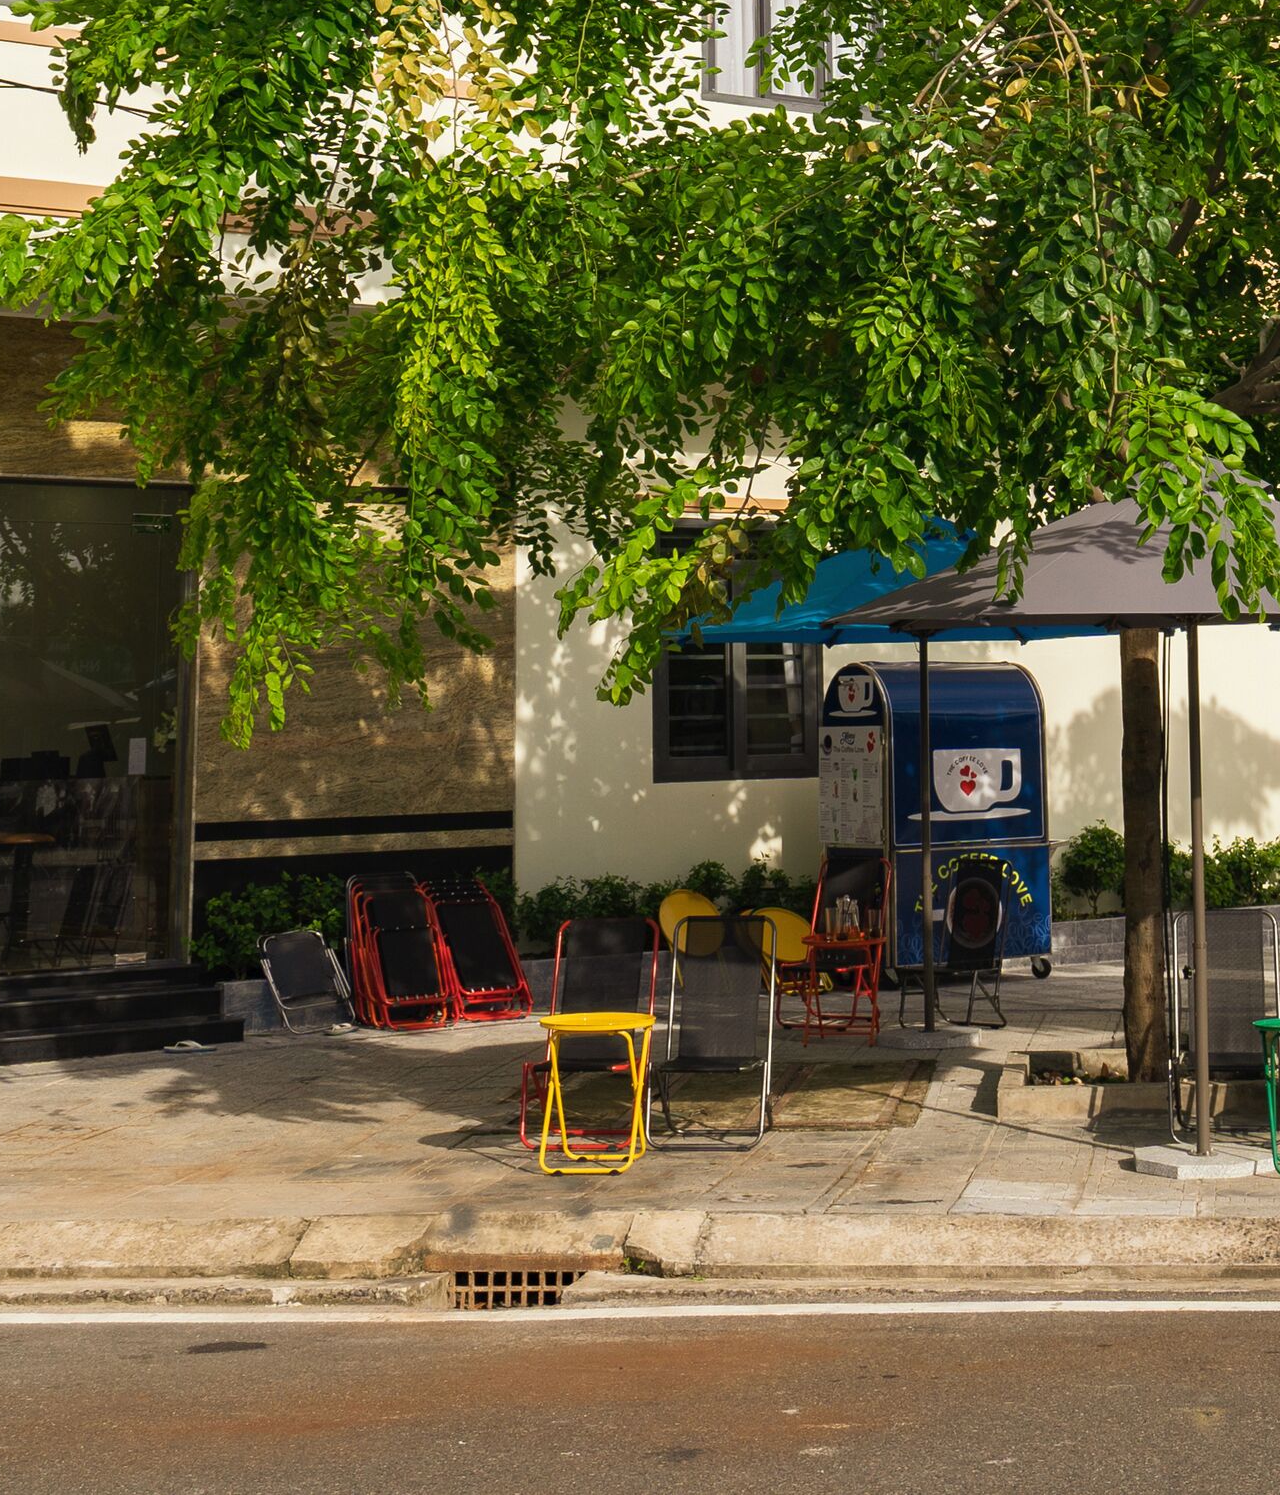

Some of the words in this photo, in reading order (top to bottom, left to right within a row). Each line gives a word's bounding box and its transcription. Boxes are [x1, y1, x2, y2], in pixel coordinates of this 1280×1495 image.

[947, 763, 956, 776] THE
[955, 755, 977, 765] COFFEE
[977, 759, 988, 774] LOVE
